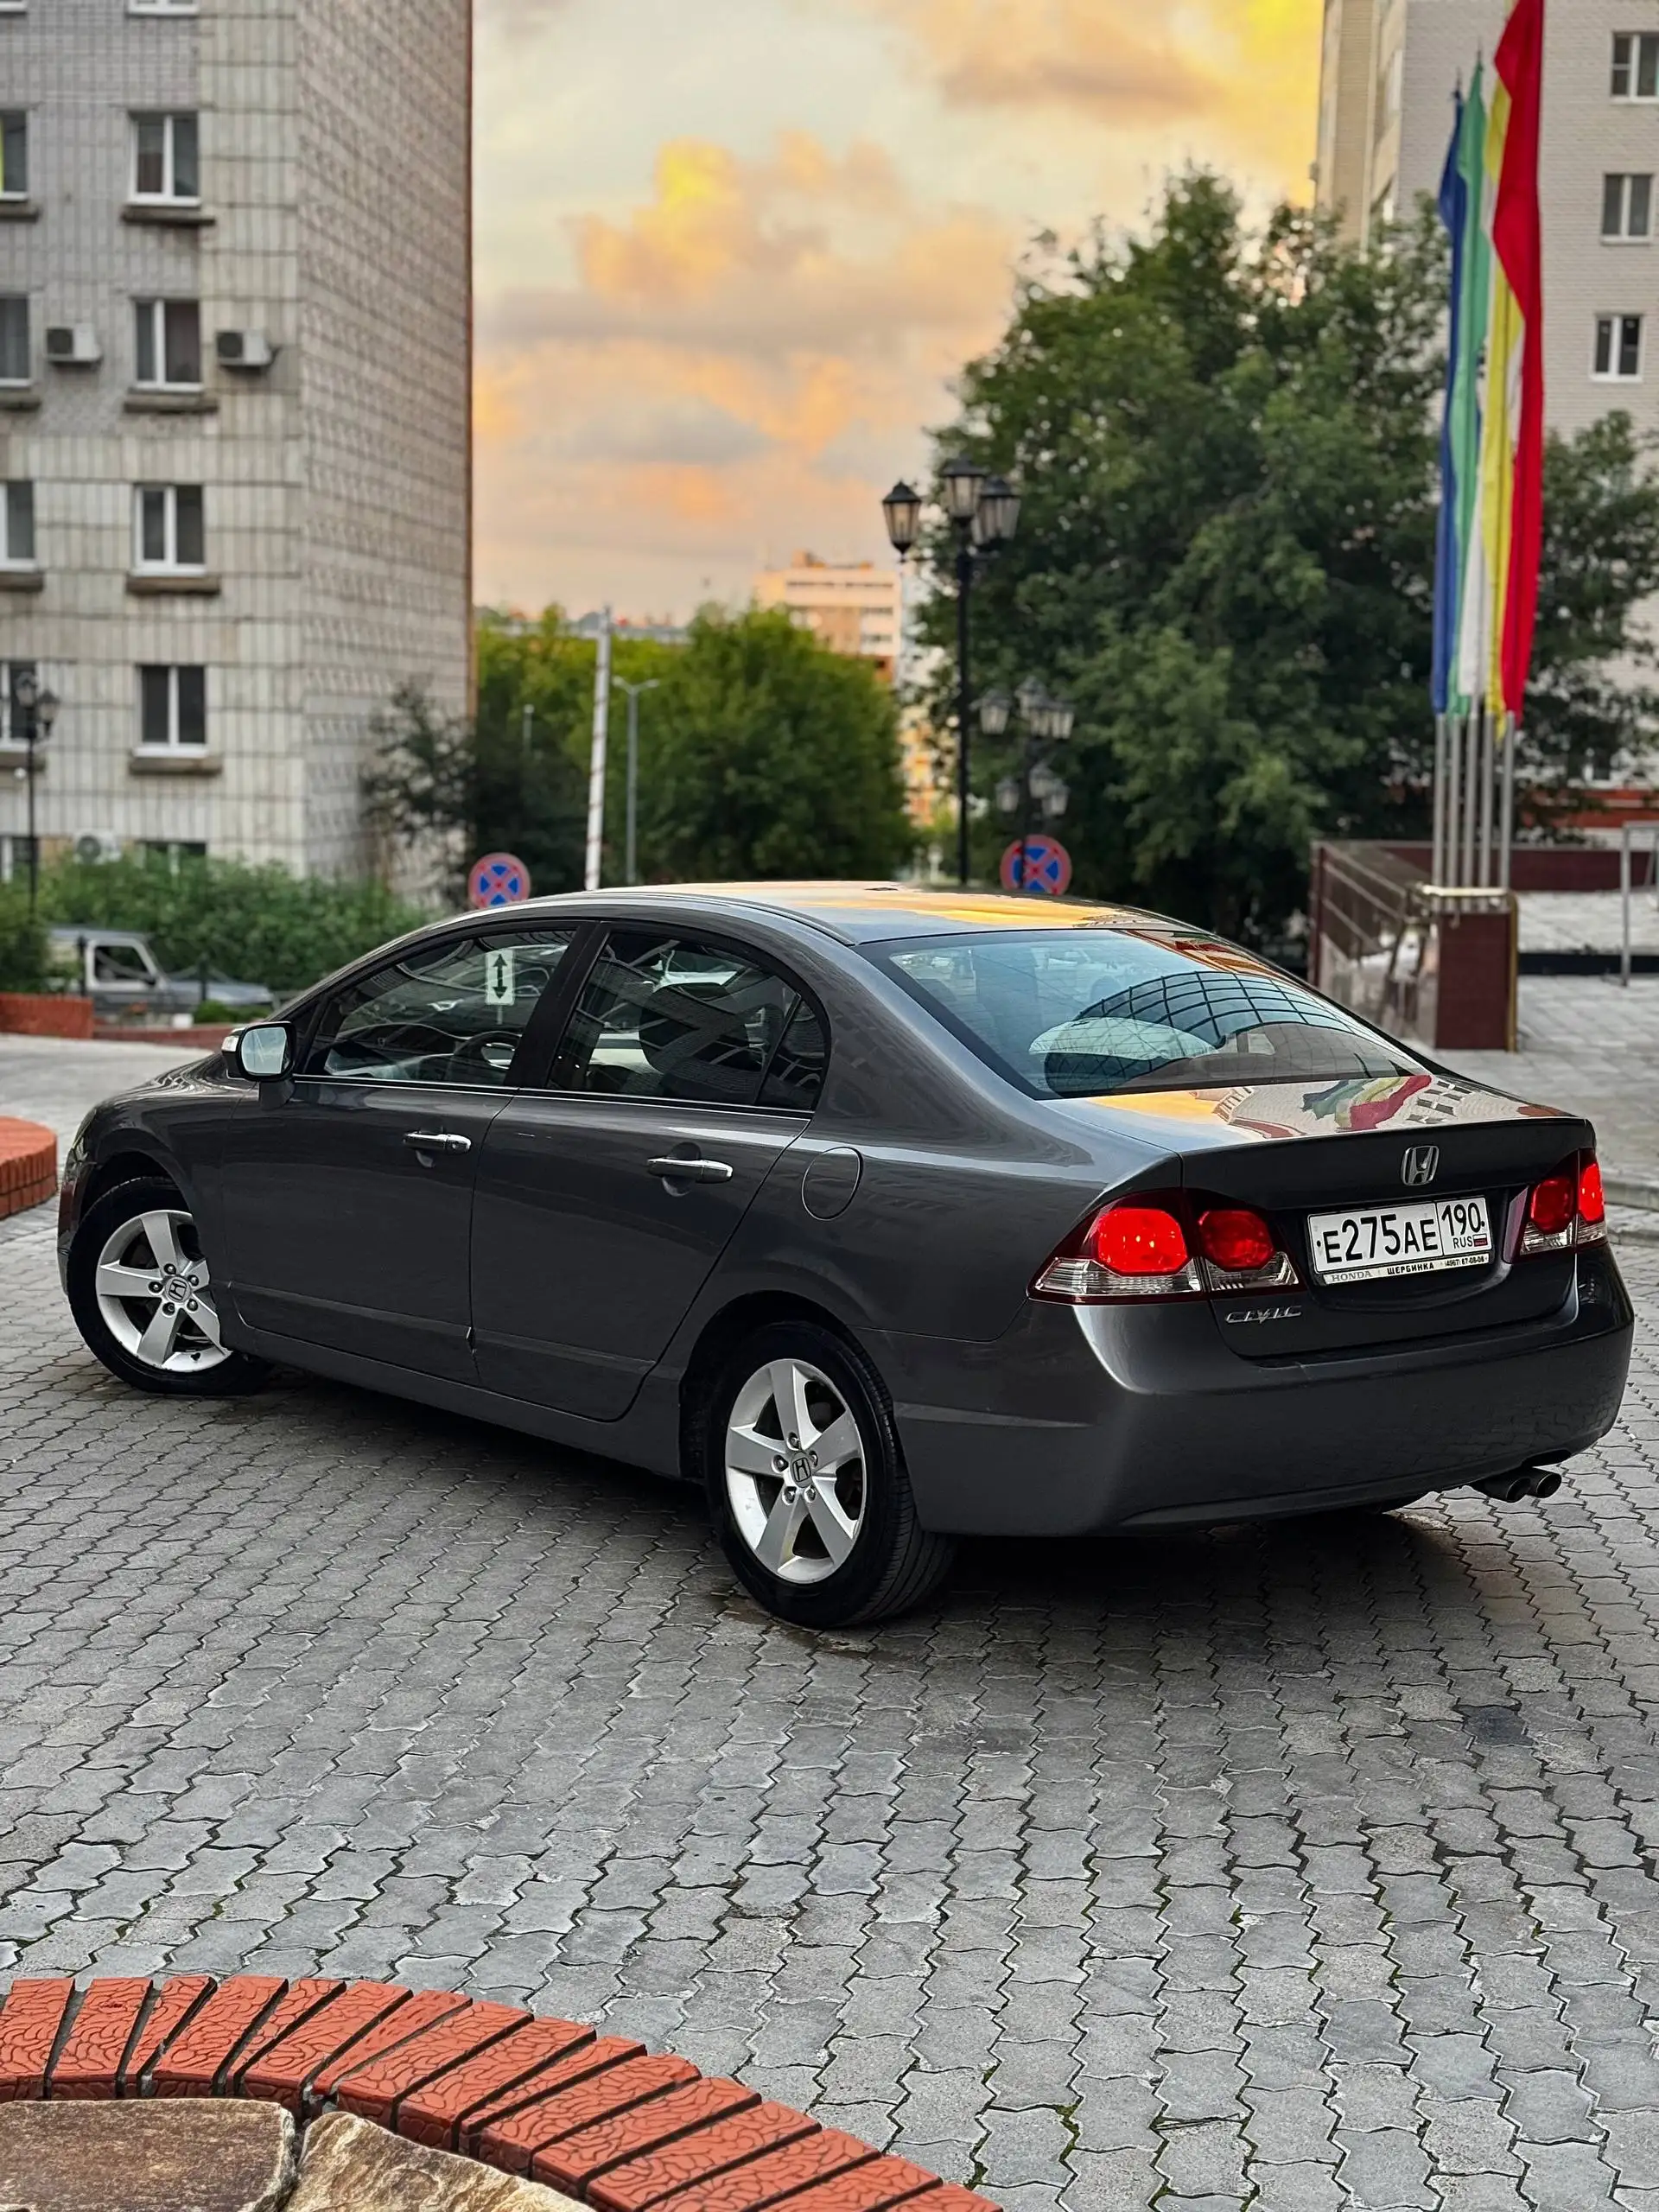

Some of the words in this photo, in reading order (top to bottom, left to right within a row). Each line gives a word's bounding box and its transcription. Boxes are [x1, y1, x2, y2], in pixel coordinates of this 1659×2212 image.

[1441, 1202, 1481, 1236] 190
[1452, 1236, 1473, 1249] RUS
[1387, 1262, 1434, 1274] ЩЕРБИНКА
[1332, 1271, 1372, 1281] HONDA
[1225, 1306, 1301, 1324] CIVIC
